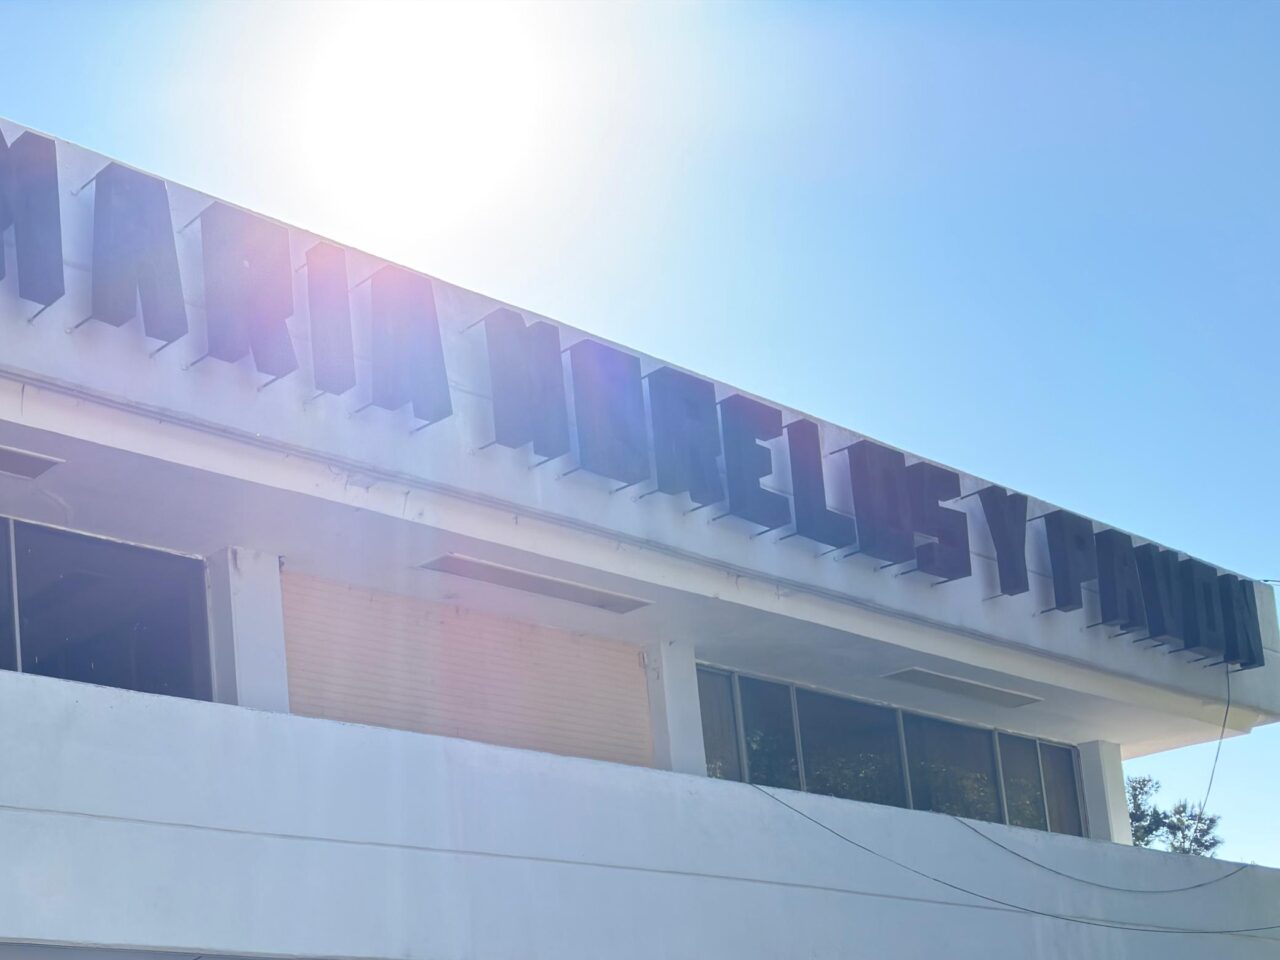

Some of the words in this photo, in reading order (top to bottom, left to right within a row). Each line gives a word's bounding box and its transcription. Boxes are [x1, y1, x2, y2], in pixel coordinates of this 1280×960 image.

[483, 307, 972, 579] MORELOS
[976, 484, 1029, 597] Y
[1044, 508, 1266, 670] PAVON
